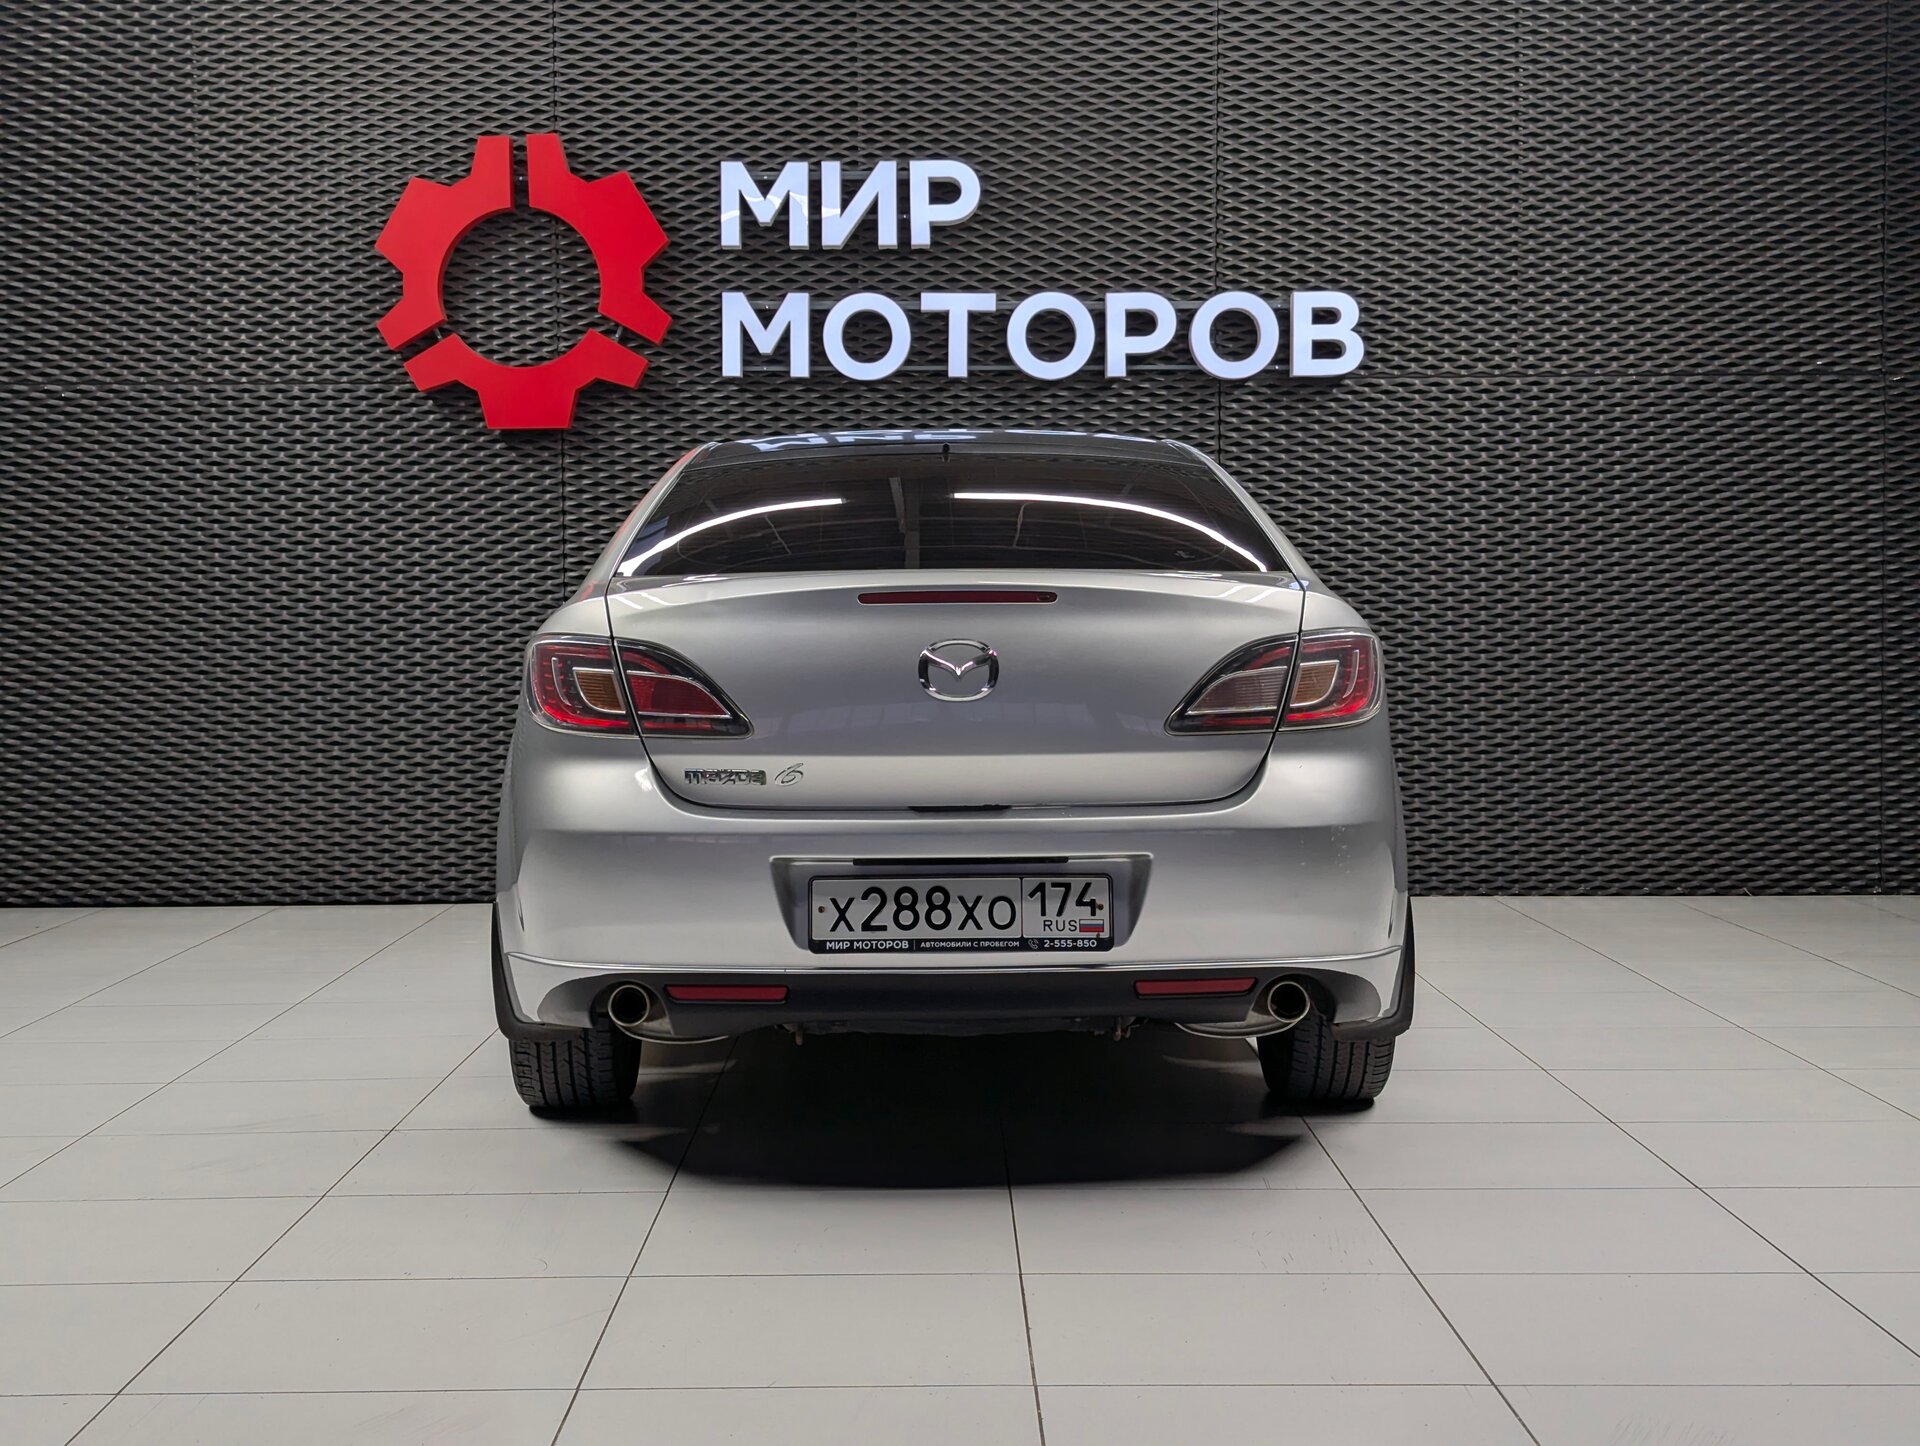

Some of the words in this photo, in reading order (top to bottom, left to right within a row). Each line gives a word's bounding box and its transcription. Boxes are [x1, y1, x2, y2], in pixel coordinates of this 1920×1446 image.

[720, 160, 982, 250] МИР
[721, 290, 1366, 381] МОТОРОВ
[774, 763, 804, 787] 6
[1027, 882, 1097, 917] 174
[1042, 919, 1077, 932] RUS
[826, 941, 850, 950] МИР
[853, 940, 909, 949] МОТОРОВ
[1043, 939, 1097, 948] 2-555-850
